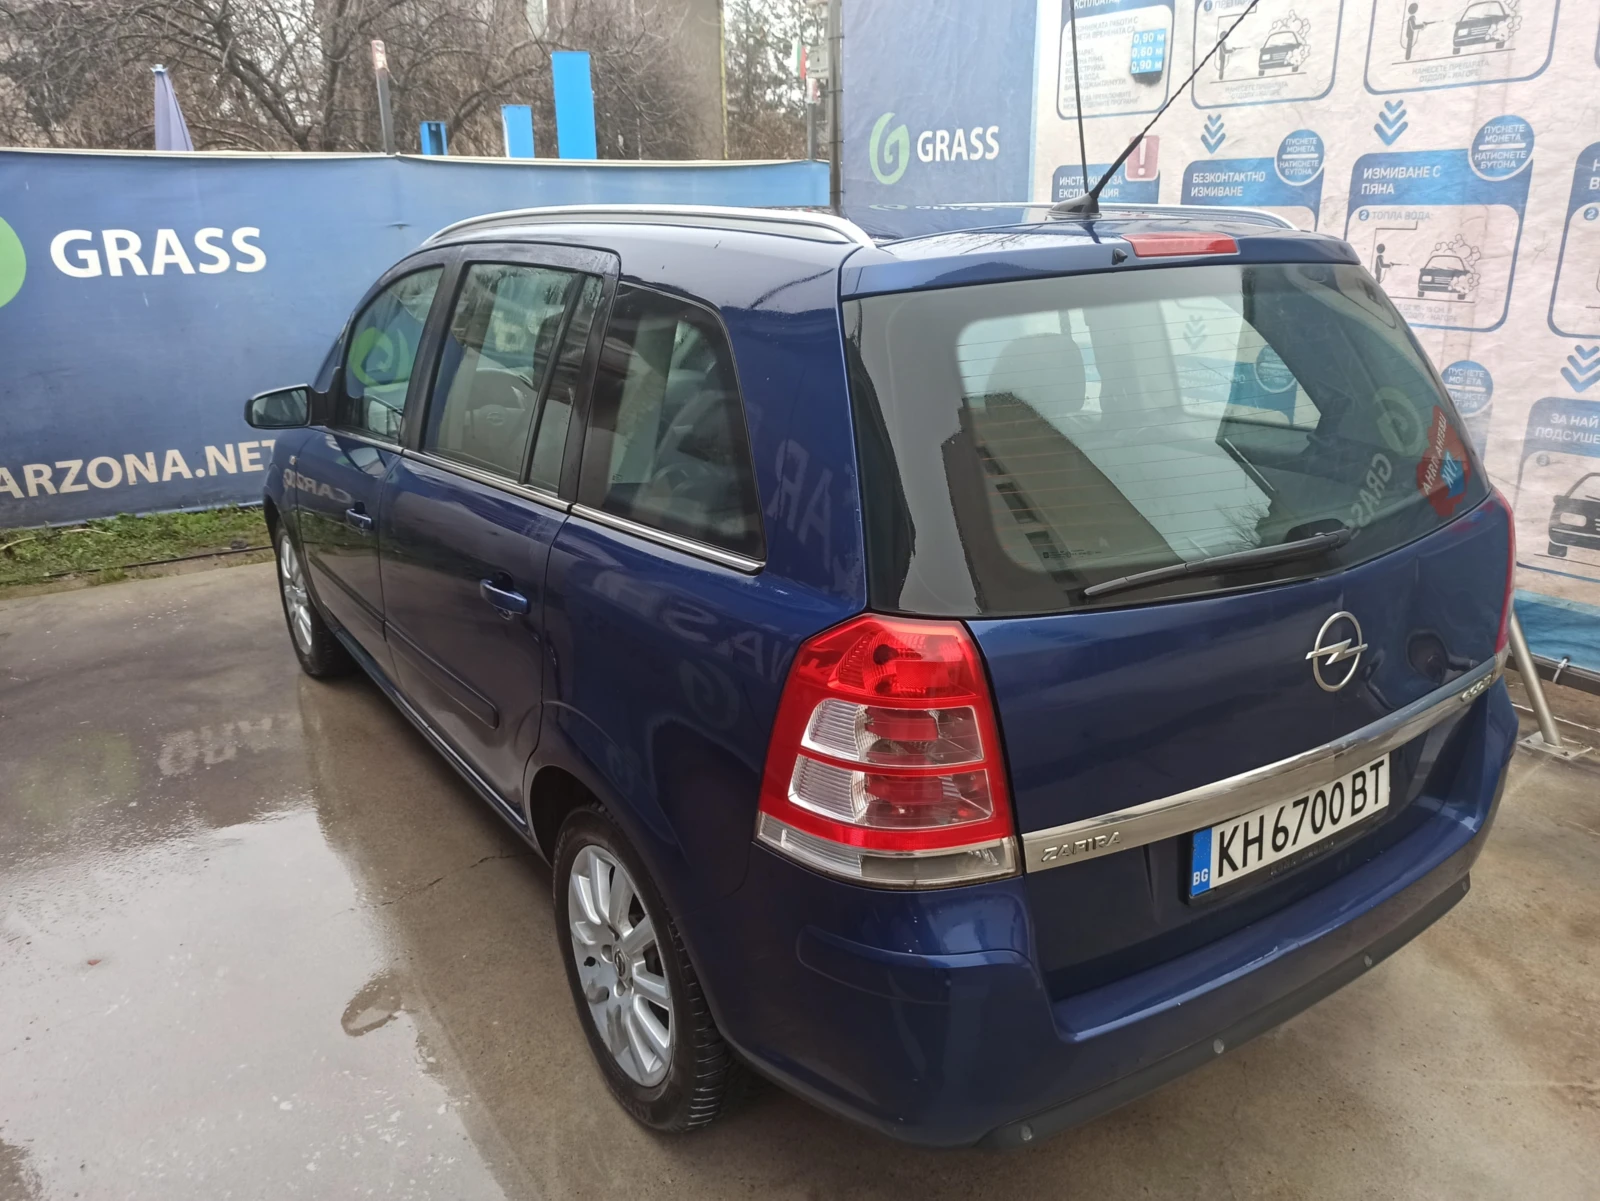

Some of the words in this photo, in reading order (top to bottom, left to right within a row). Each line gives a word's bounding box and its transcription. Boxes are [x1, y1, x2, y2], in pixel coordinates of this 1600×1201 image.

[1133, 32, 1154, 45] 0,90
[1131, 46, 1152, 60] 0,60
[1131, 59, 1152, 73] 0,90
[1483, 124, 1526, 134] ПУСНЕТЕ
[917, 126, 999, 162] GRASS
[1285, 137, 1318, 146] ПУСНЕТЕ
[1484, 133, 1521, 143] МОНЕТА
[1286, 145, 1315, 153] МОНЕТА
[1474, 150, 1527, 161] НАТИСНЕТЕ
[1280, 160, 1319, 169] НАТИСНЕТЕ
[1480, 160, 1516, 170] БУТОНА
[1192, 171, 1266, 184] БЕЗКОНТАКТНО
[1284, 167, 1312, 176] БУТОНА
[1363, 166, 1430, 180] ИЗМИВАНЕ
[1432, 165, 1441, 178] С
[1190, 186, 1244, 197] ИЗМИВАНЕ
[1361, 183, 1395, 195] ПЯНА
[1372, 211, 1402, 221] ТОПЛА
[1404, 211, 1431, 221] ВОДА
[1585, 208, 1597, 220] 2
[50, 227, 267, 278] GRASS
[1550, 413, 1568, 425] ЗА
[1569, 413, 1599, 429] НАЙ
[1041, 831, 1121, 862] ZAFIRA
[1193, 868, 1209, 886] BG
